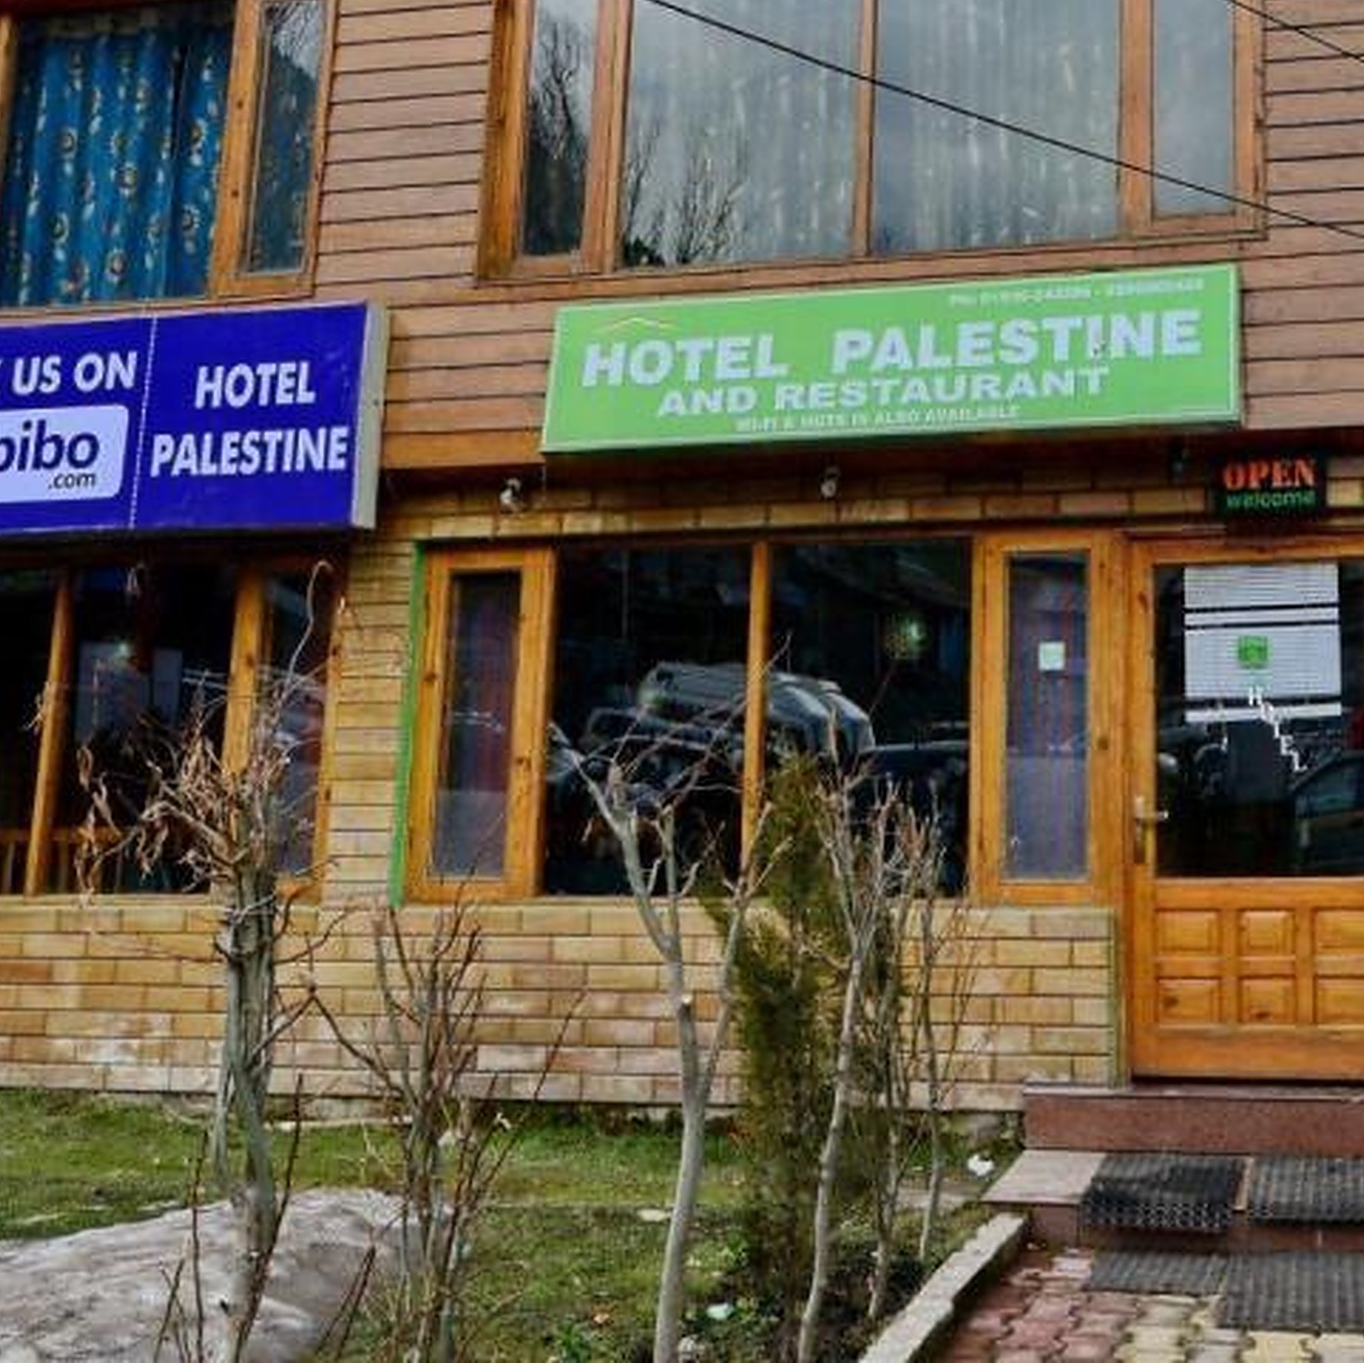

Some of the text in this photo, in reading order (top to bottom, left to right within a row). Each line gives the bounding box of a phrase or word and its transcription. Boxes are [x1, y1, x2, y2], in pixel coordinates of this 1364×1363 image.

[582, 309, 1203, 386] HOTEL PALESTINE
[12, 355, 61, 394] US
[73, 351, 136, 391] ON
[194, 361, 316, 408] HOTEL
[658, 366, 1110, 416] AND RESTAURANT
[925, 404, 1021, 423] AVAILABLE
[149, 427, 349, 478] PALESTINE
[1224, 459, 1315, 489] OPEN
[47, 471, 97, 490] .com
[1226, 490, 1317, 509] welcome
